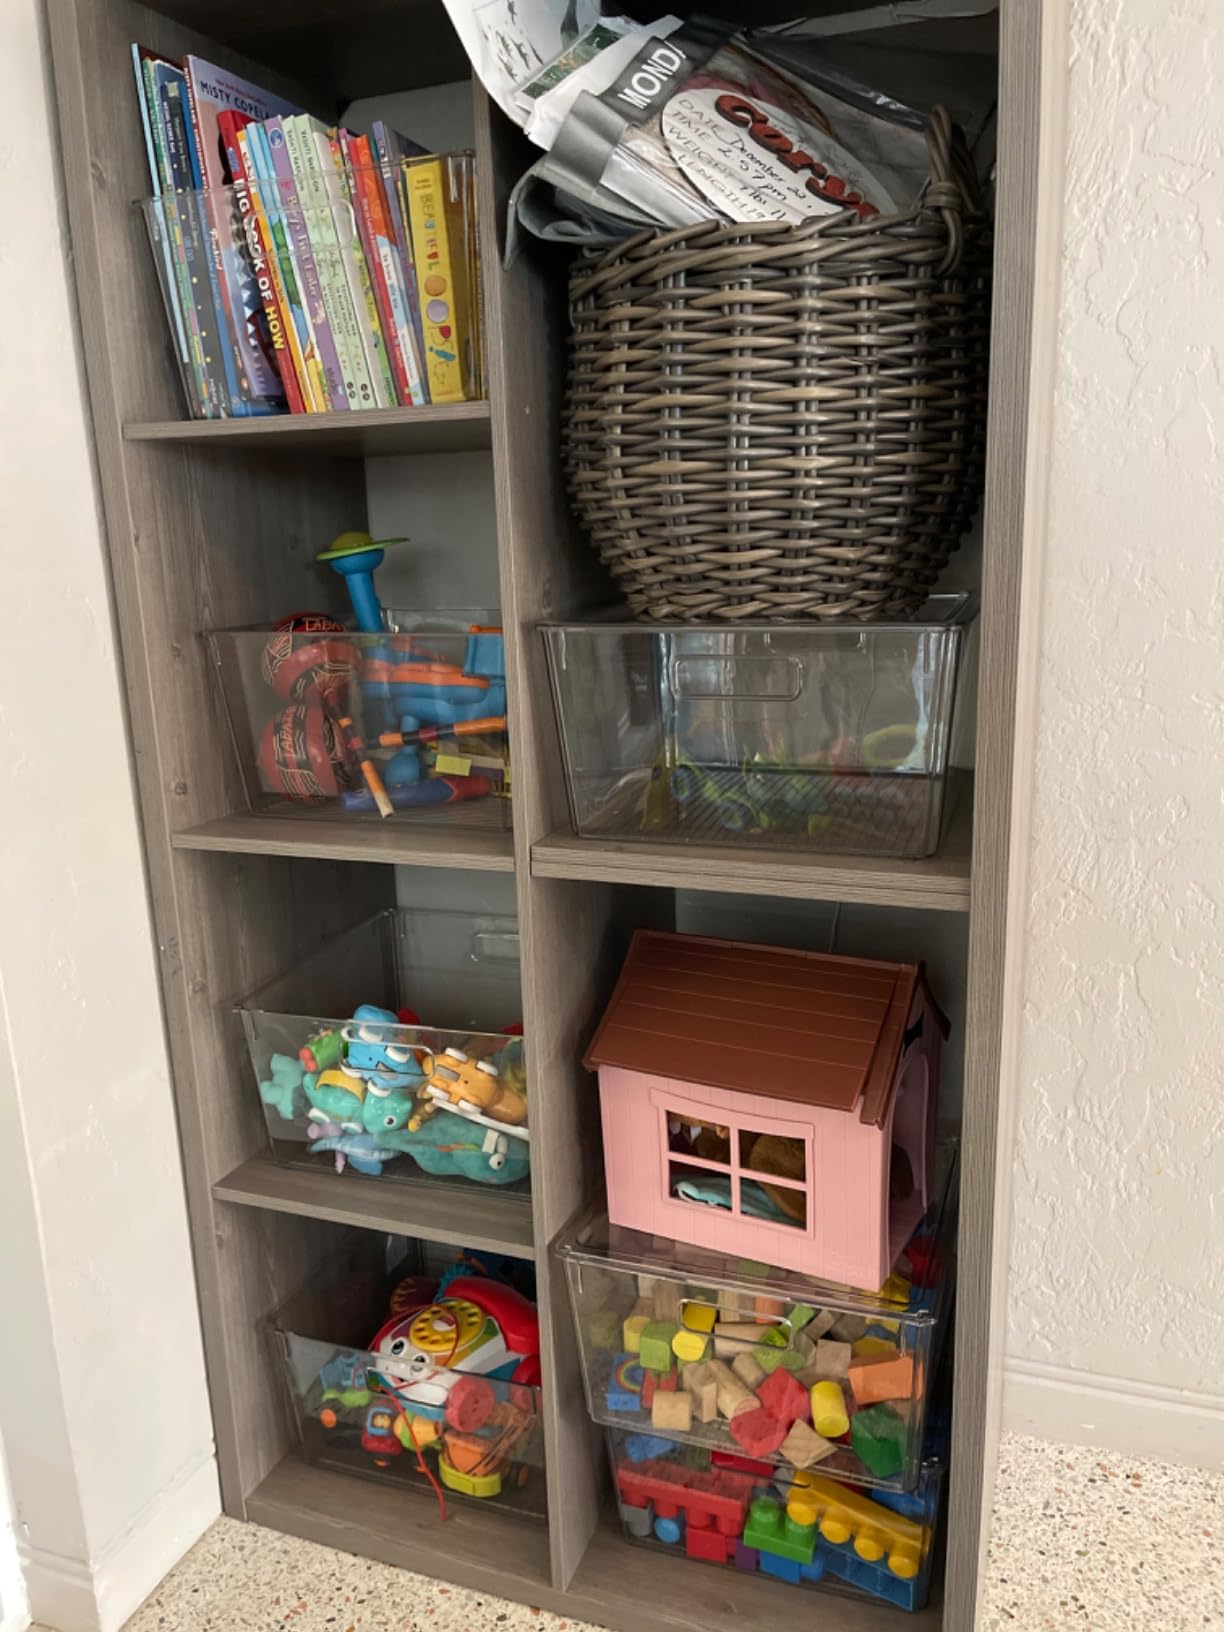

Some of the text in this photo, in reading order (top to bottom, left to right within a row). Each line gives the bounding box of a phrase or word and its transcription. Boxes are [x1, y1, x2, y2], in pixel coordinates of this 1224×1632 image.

[200, 80, 231, 104] MISTY
[233, 97, 271, 119] COPELA
[669, 126, 736, 178] WEIGHT
[671, 111, 712, 142] TIME
[760, 183, 787, 202] pm
[678, 98, 727, 140] DATE
[730, 132, 786, 183] December
[678, 154, 749, 212] LENGTH
[255, 274, 273, 302] OF
[263, 304, 286, 351] HOW
